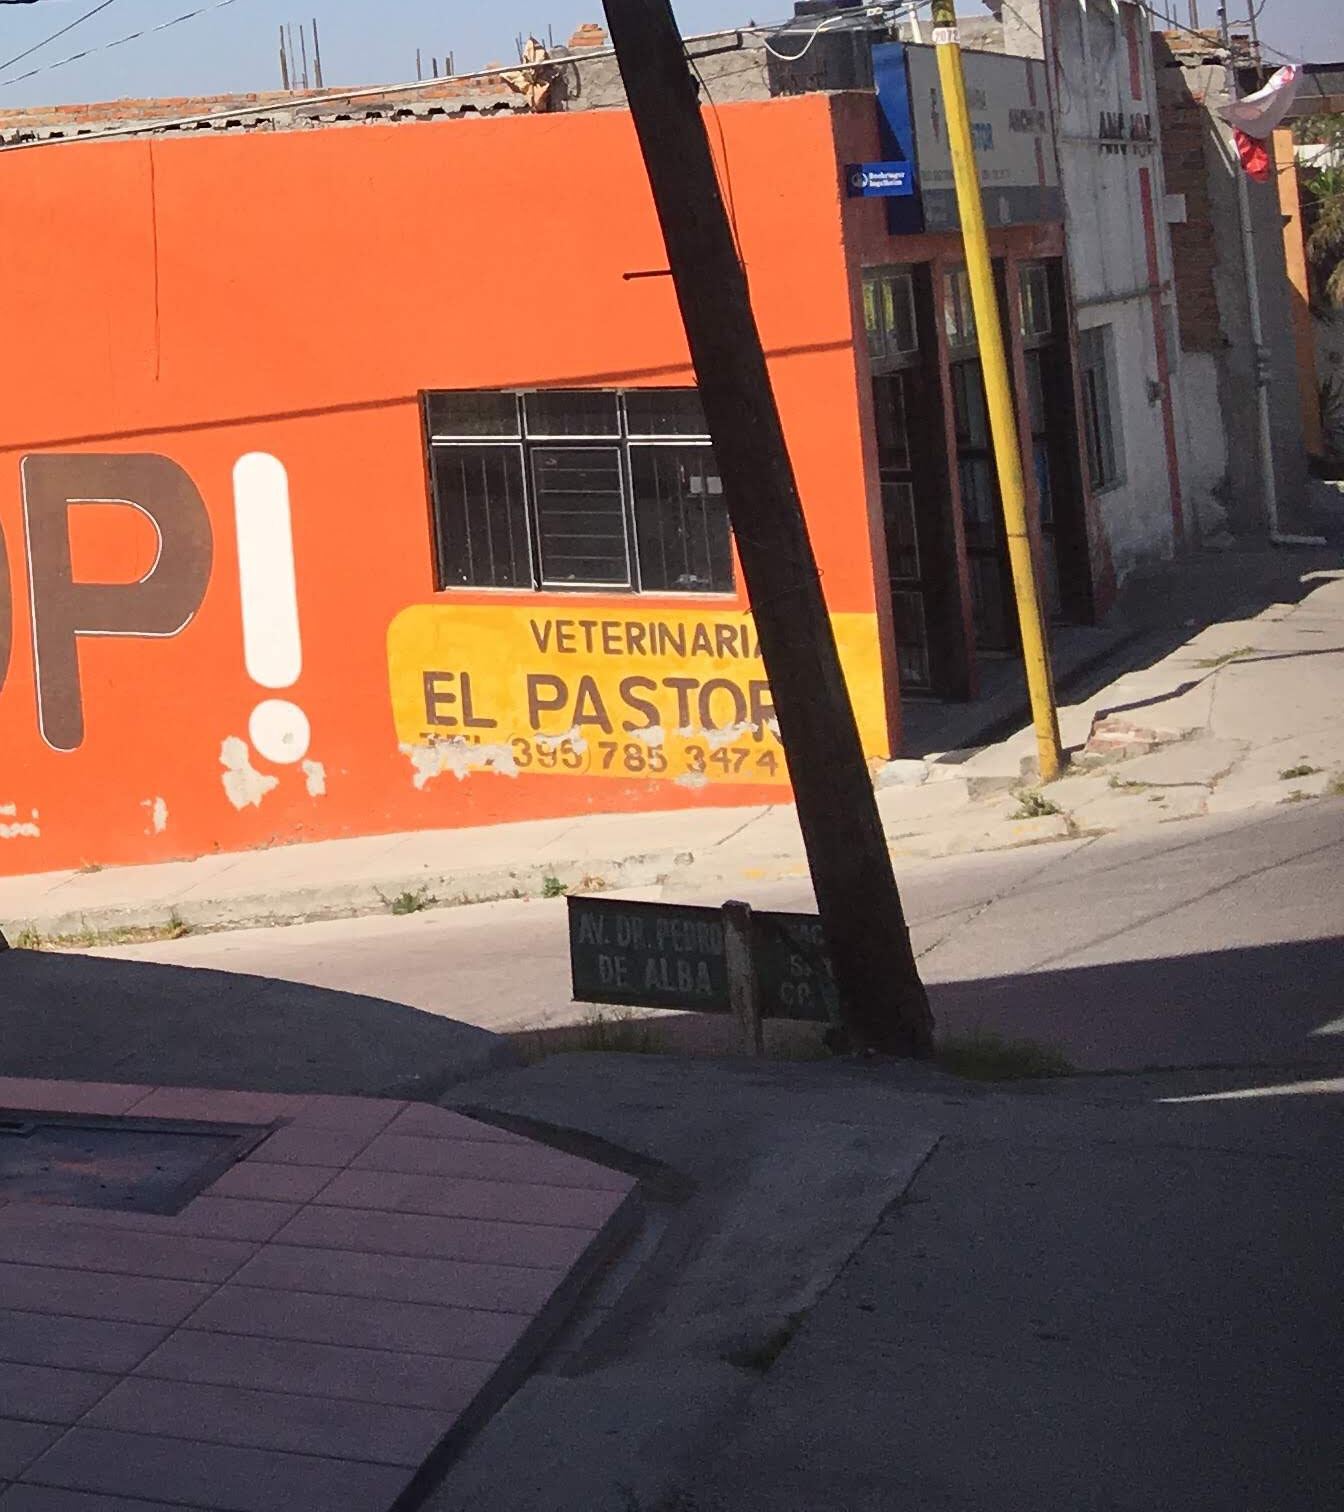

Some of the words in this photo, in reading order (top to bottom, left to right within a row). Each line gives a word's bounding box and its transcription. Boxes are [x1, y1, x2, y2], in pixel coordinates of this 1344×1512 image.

[422, 670, 497, 729] EL
[597, 740, 669, 774] 785
[577, 911, 611, 945] AV.
[656, 918, 722, 955] PEDRO
[598, 953, 628, 987] DE
[646, 957, 713, 996] ALBA
